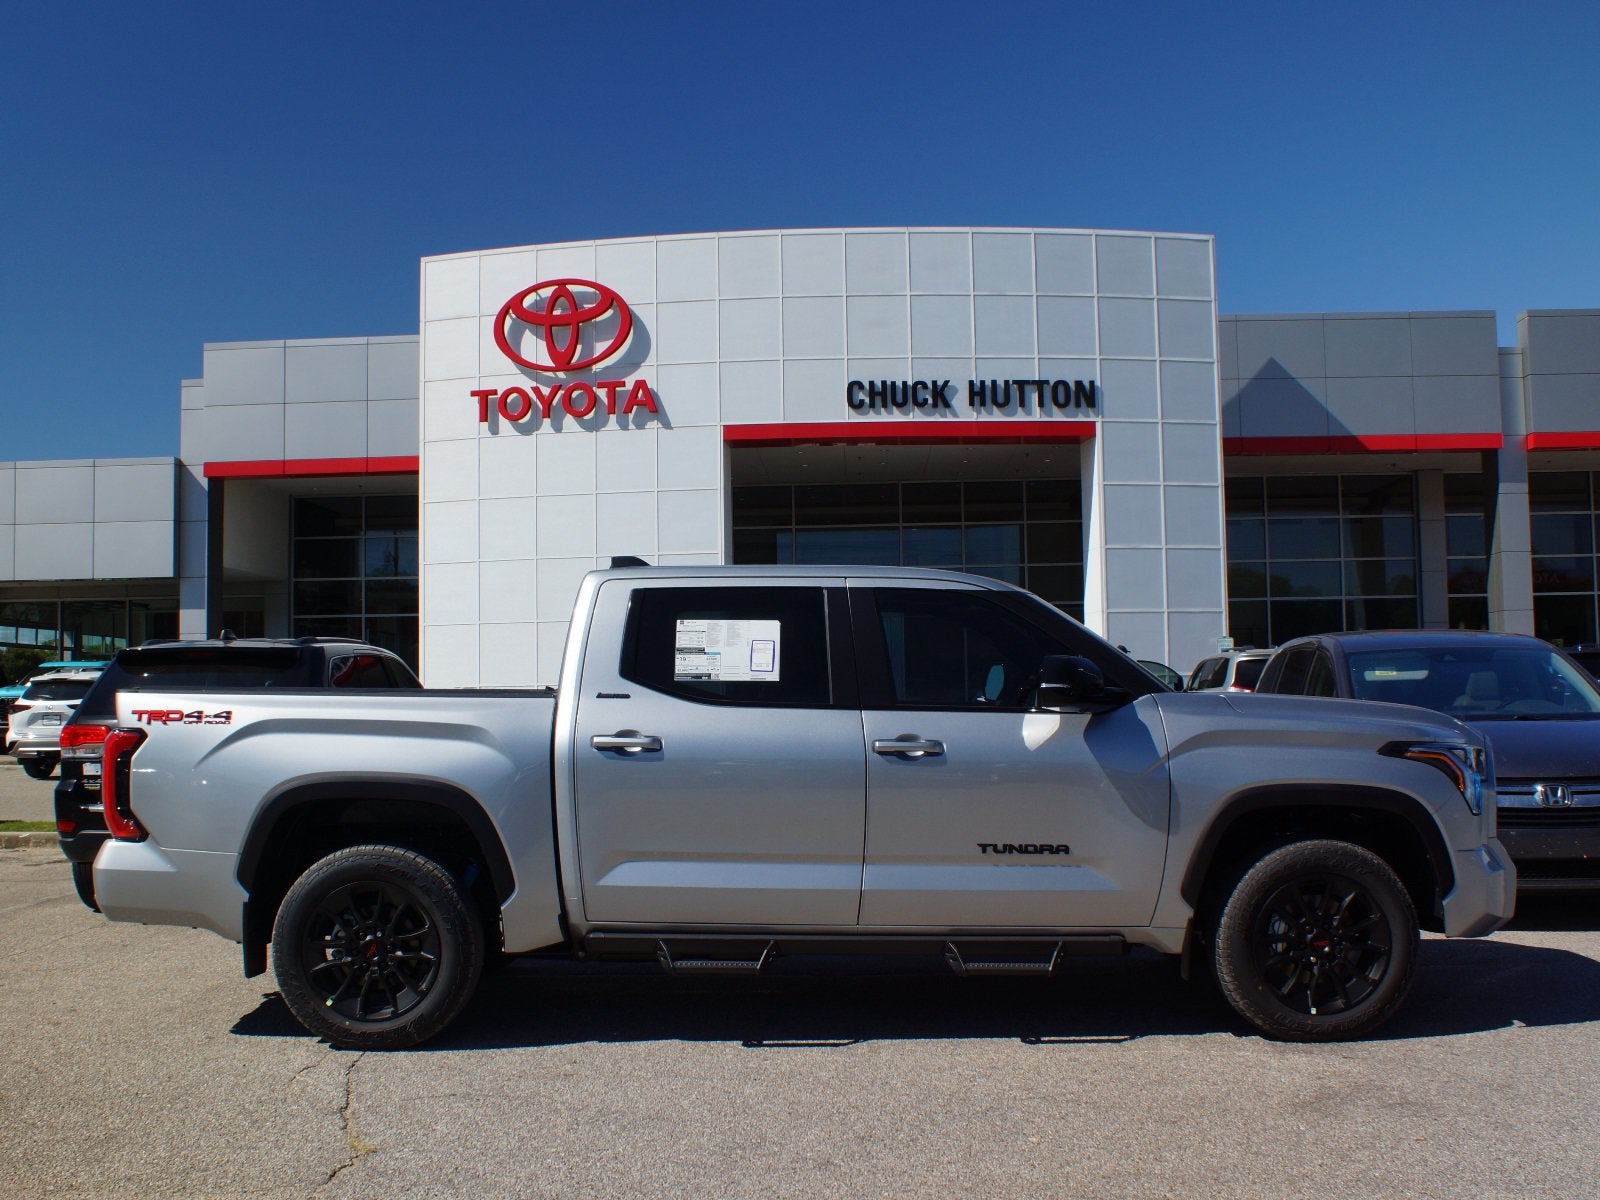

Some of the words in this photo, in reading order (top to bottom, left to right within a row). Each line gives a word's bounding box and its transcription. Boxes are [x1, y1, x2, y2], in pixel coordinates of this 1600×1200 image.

[470, 379, 658, 423] TOYOTA
[847, 379, 952, 409] CHUCK
[968, 379, 1096, 409] HUTTON
[131, 709, 184, 726] TRD
[977, 843, 1070, 855] TUNDRA
